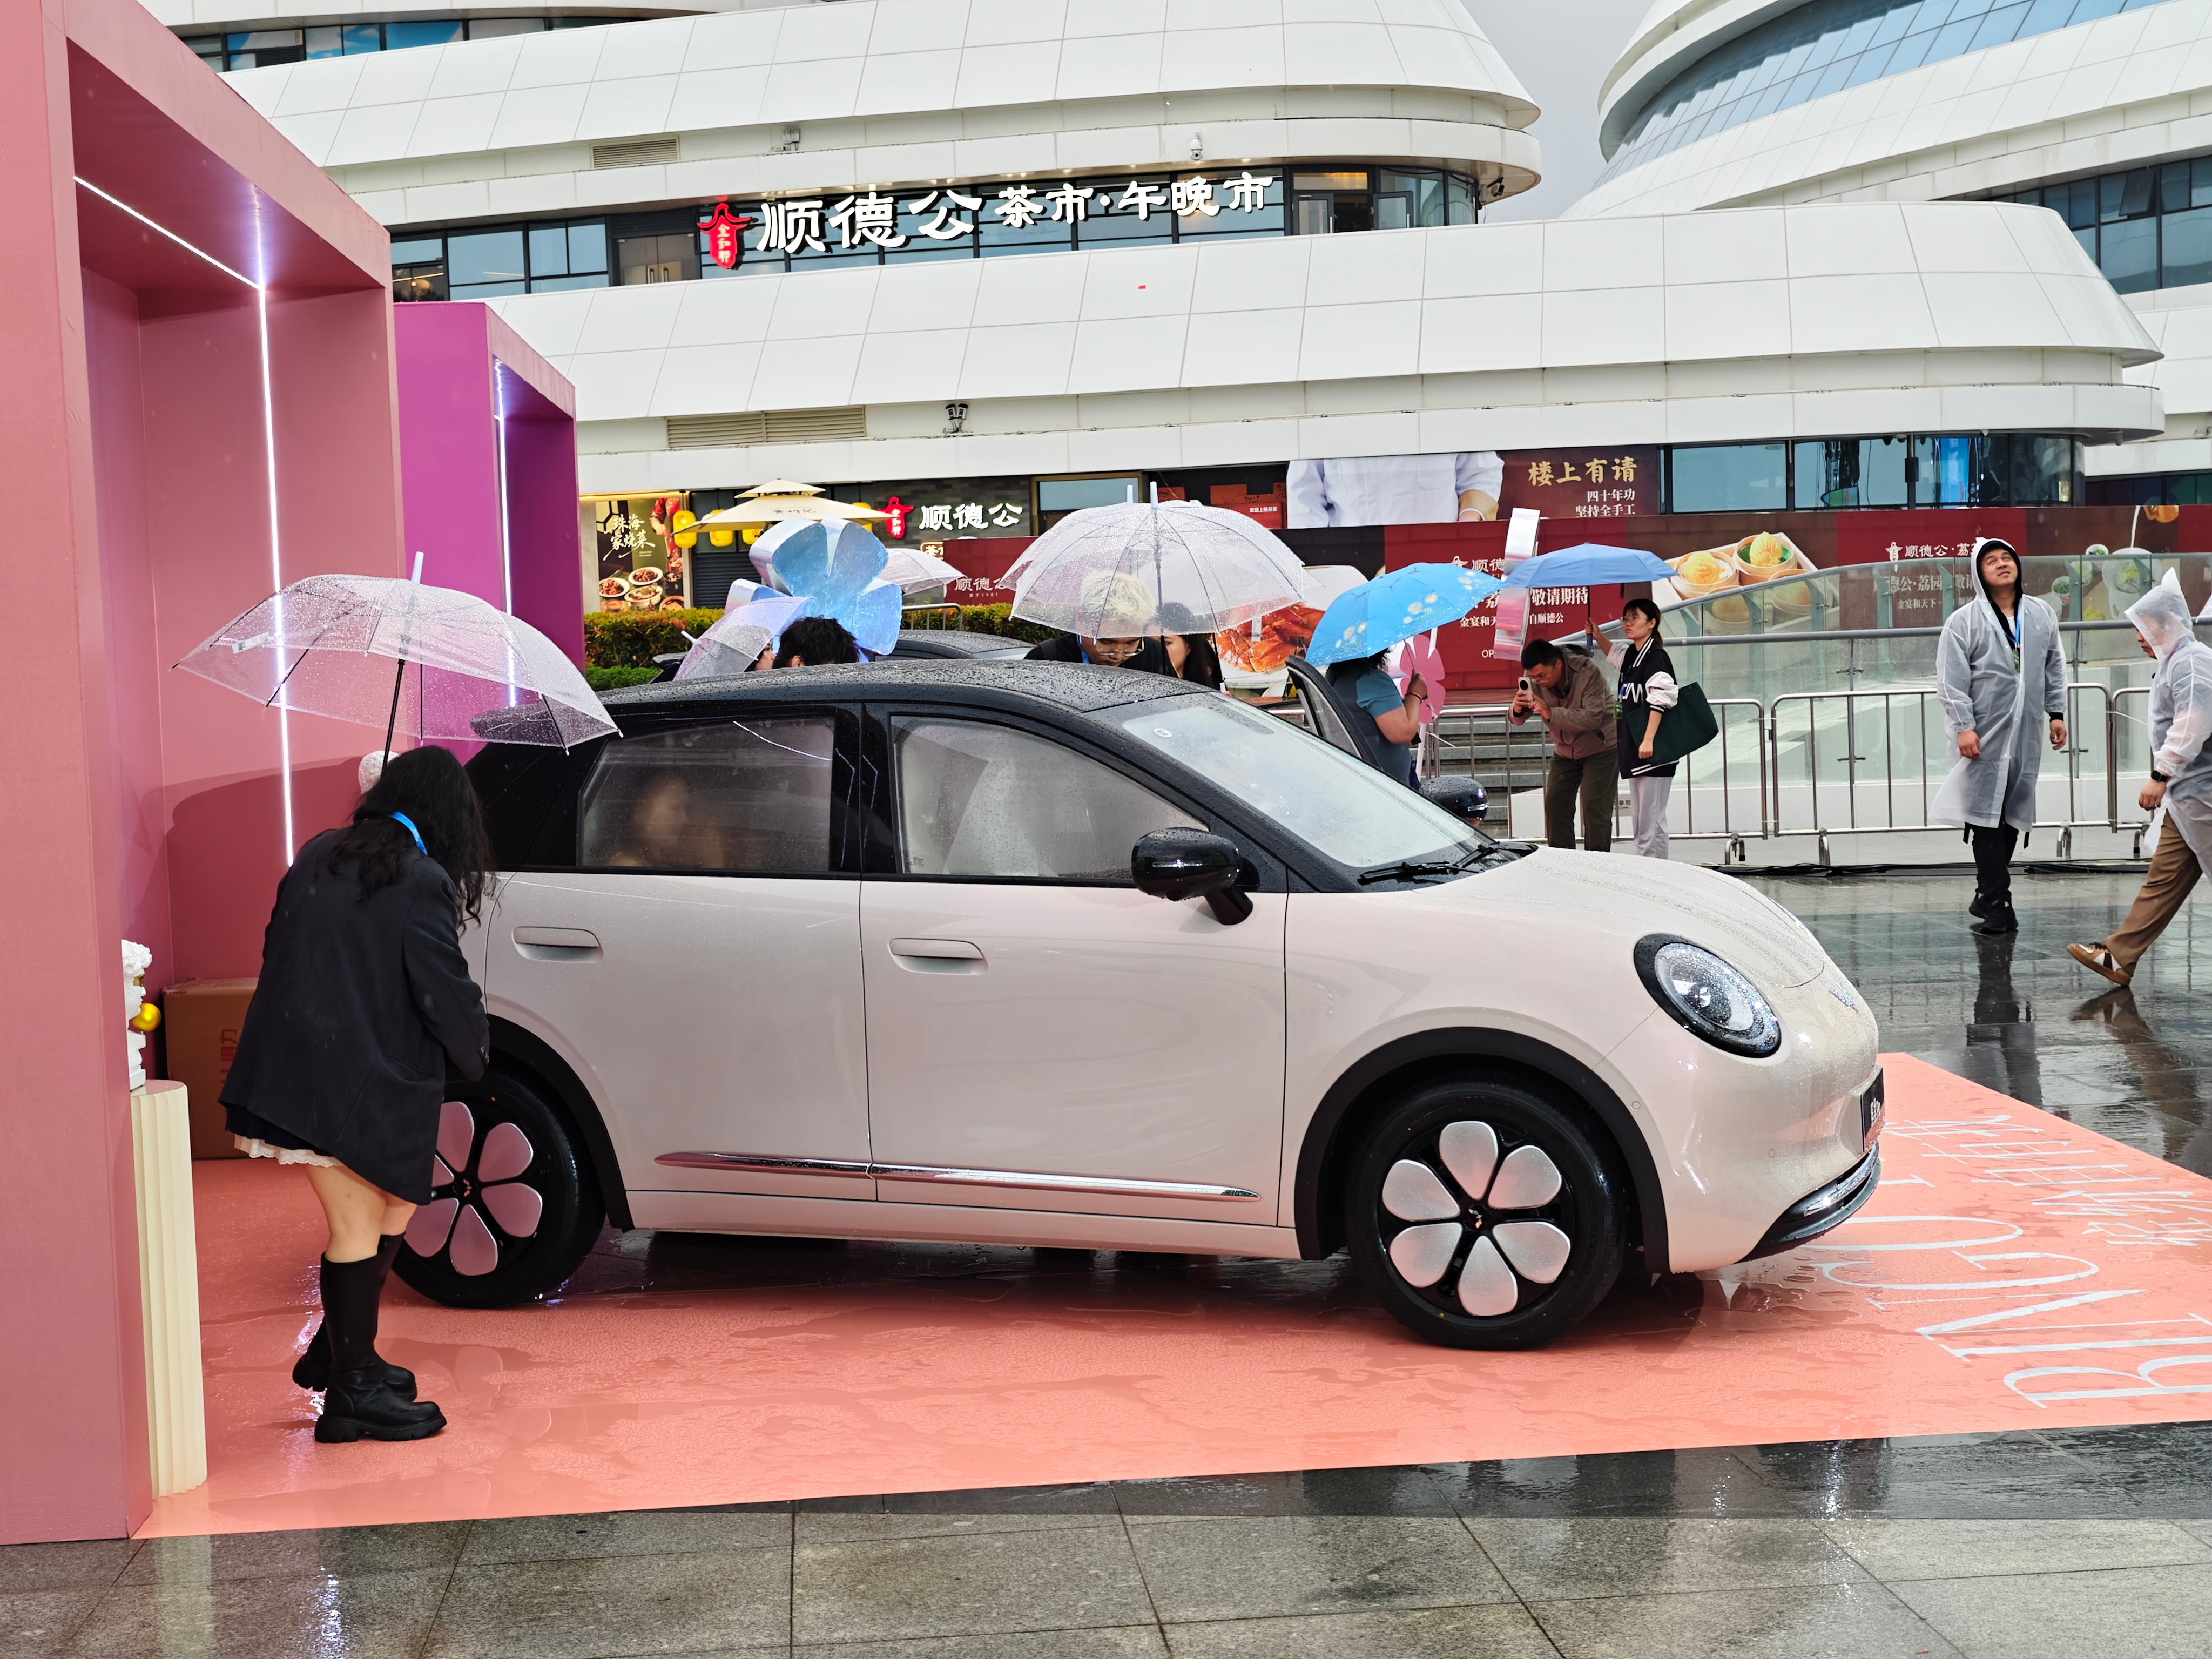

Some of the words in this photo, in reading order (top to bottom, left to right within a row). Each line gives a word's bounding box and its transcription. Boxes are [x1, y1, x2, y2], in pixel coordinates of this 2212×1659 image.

[1528, 456, 1637, 487] 楼上有请
[1587, 488, 1635, 503] 四十年功
[919, 503, 1023, 531] 顺德公
[1575, 503, 1636, 518] 坚持全手工
[603, 514, 645, 534] 珠海
[603, 529, 656, 561] 家烧菜
[1532, 586, 1588, 606] 敬请期待
